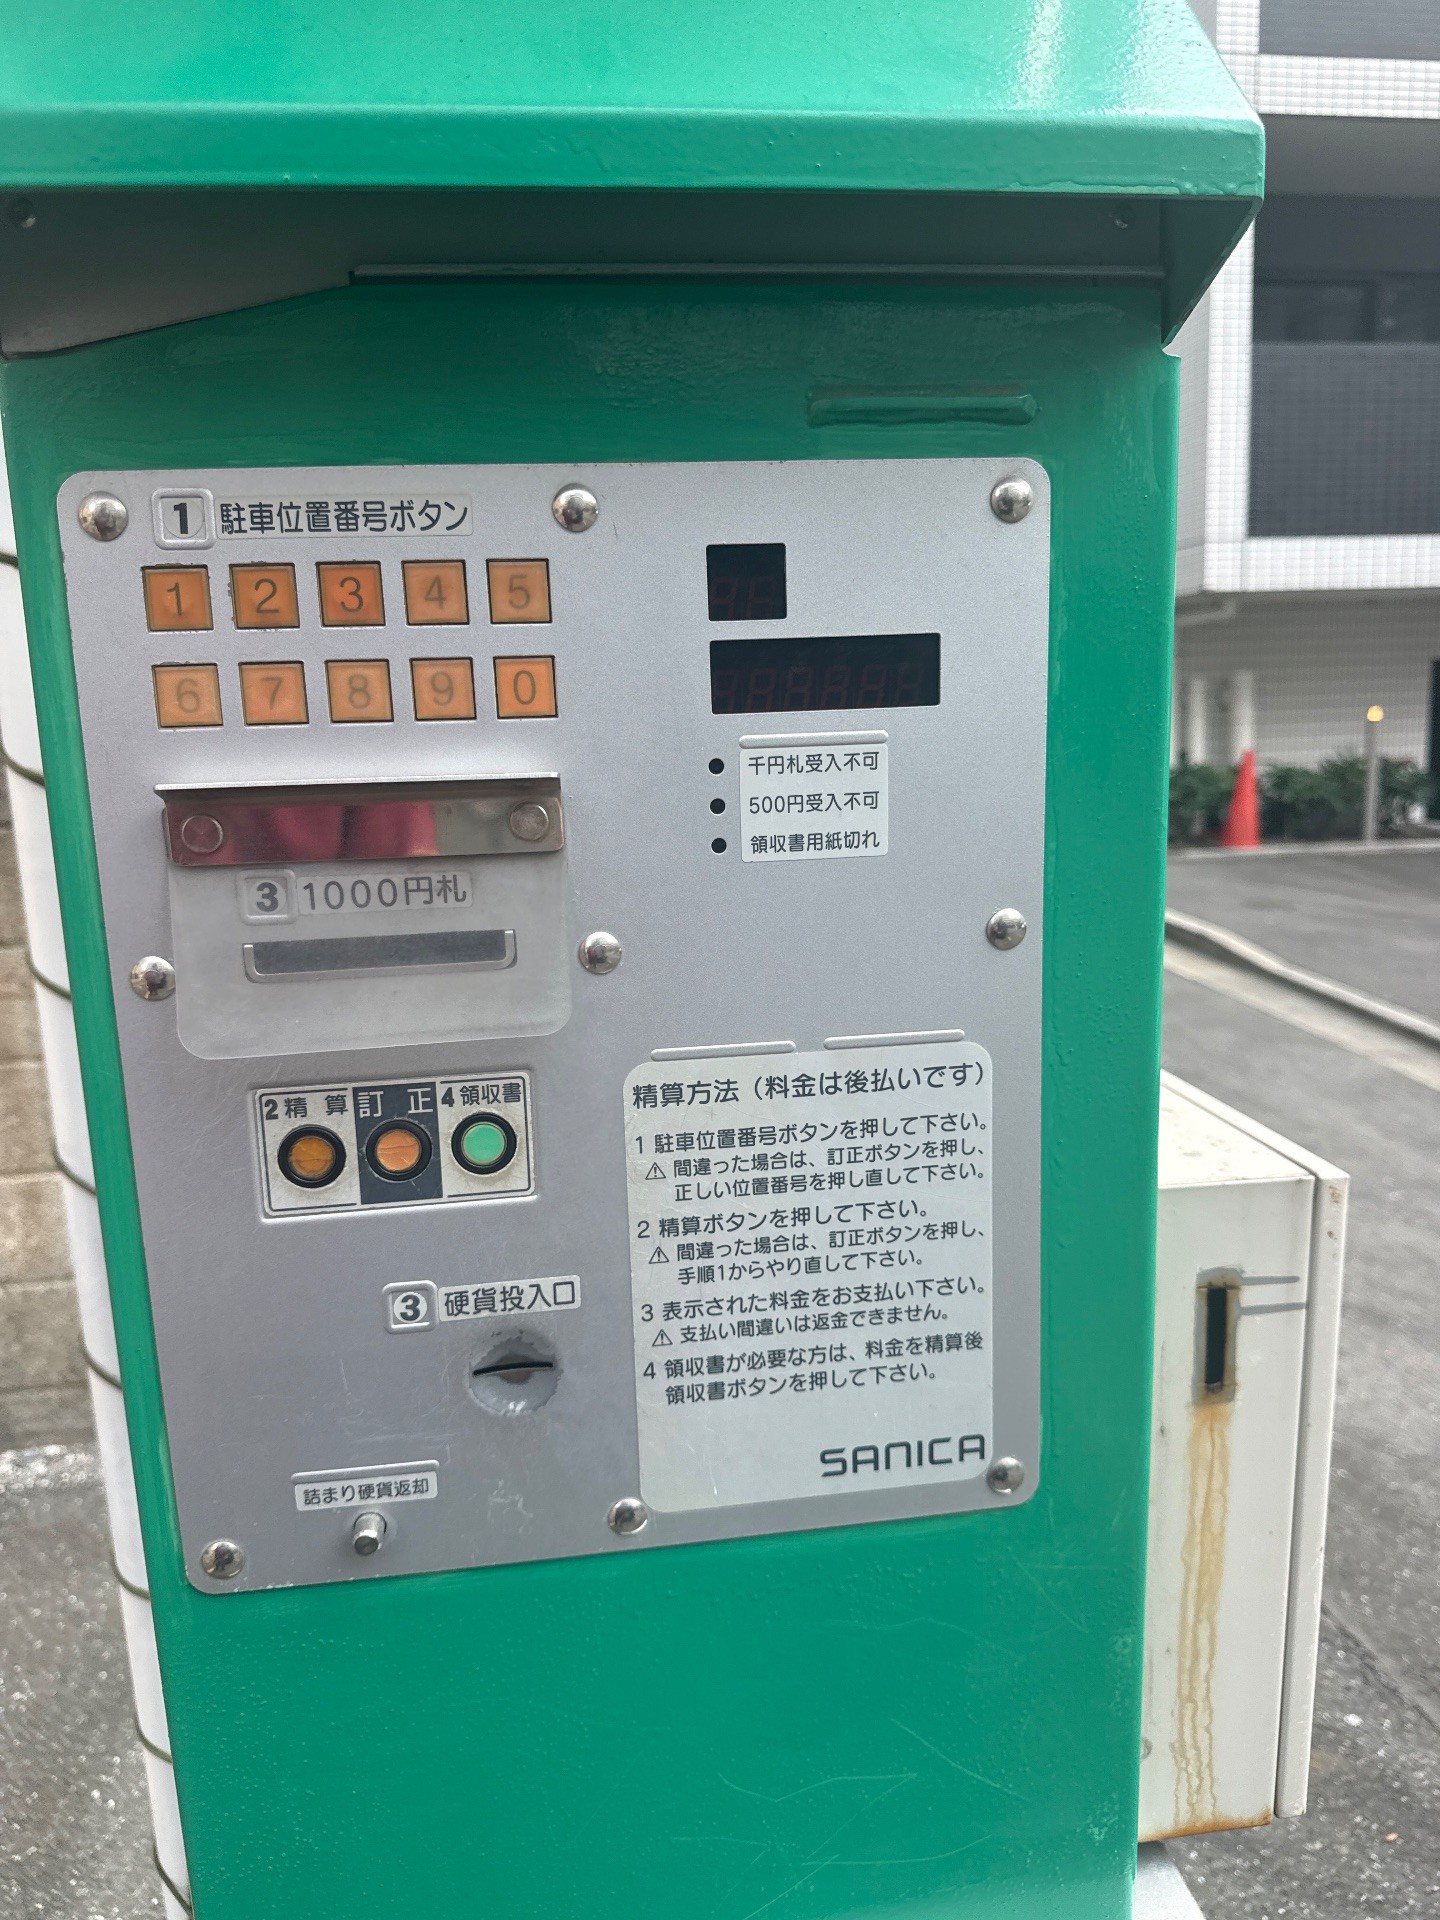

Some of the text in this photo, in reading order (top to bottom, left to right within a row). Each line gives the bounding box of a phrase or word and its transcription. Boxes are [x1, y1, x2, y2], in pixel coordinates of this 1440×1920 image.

[173, 501, 468, 535] 1 駐車位置番号ボタン
[167, 574, 532, 616] 1 2 3 4 5
[176, 669, 537, 714] 6 7 8 9 0
[748, 751, 880, 776] 千円札受入不可
[749, 790, 880, 814] 500円受入不可
[750, 830, 880, 854] 領収書用紙切れ
[257, 874, 467, 912] 3 1000円札
[265, 1099, 279, 1120] 2
[441, 1083, 522, 1107] 4 領収書
[635, 1112, 986, 1154] 1 駐車位置番号ボタンを押して下さい。
[673, 1139, 984, 1179] 間違った場合は、訂正ボタンを押し、
[675, 1162, 984, 1202] 正しい位置番号を押し直して下さい。
[637, 1199, 927, 1239] 2 精算ボタンを押して下さい。
[677, 1220, 985, 1262] 間違った場合は、訂正ボタンを押し、
[678, 1249, 922, 1285] 手順1からやり直して下さい。
[400, 1280, 575, 1321] 3 硬貨投入口
[640, 1276, 985, 1322] 3 表示された料金をお支払い下さい。
[680, 1303, 949, 1344] 支払い間違いは返金できません。
[643, 1330, 984, 1380] 4 領収書が必要な方は、料金を精算後
[665, 1362, 936, 1405] 領収書ボタンを押して下さい。
[820, 1433, 985, 1477] SANICA
[303, 1478, 429, 1505] 詰まり硬貨返却
